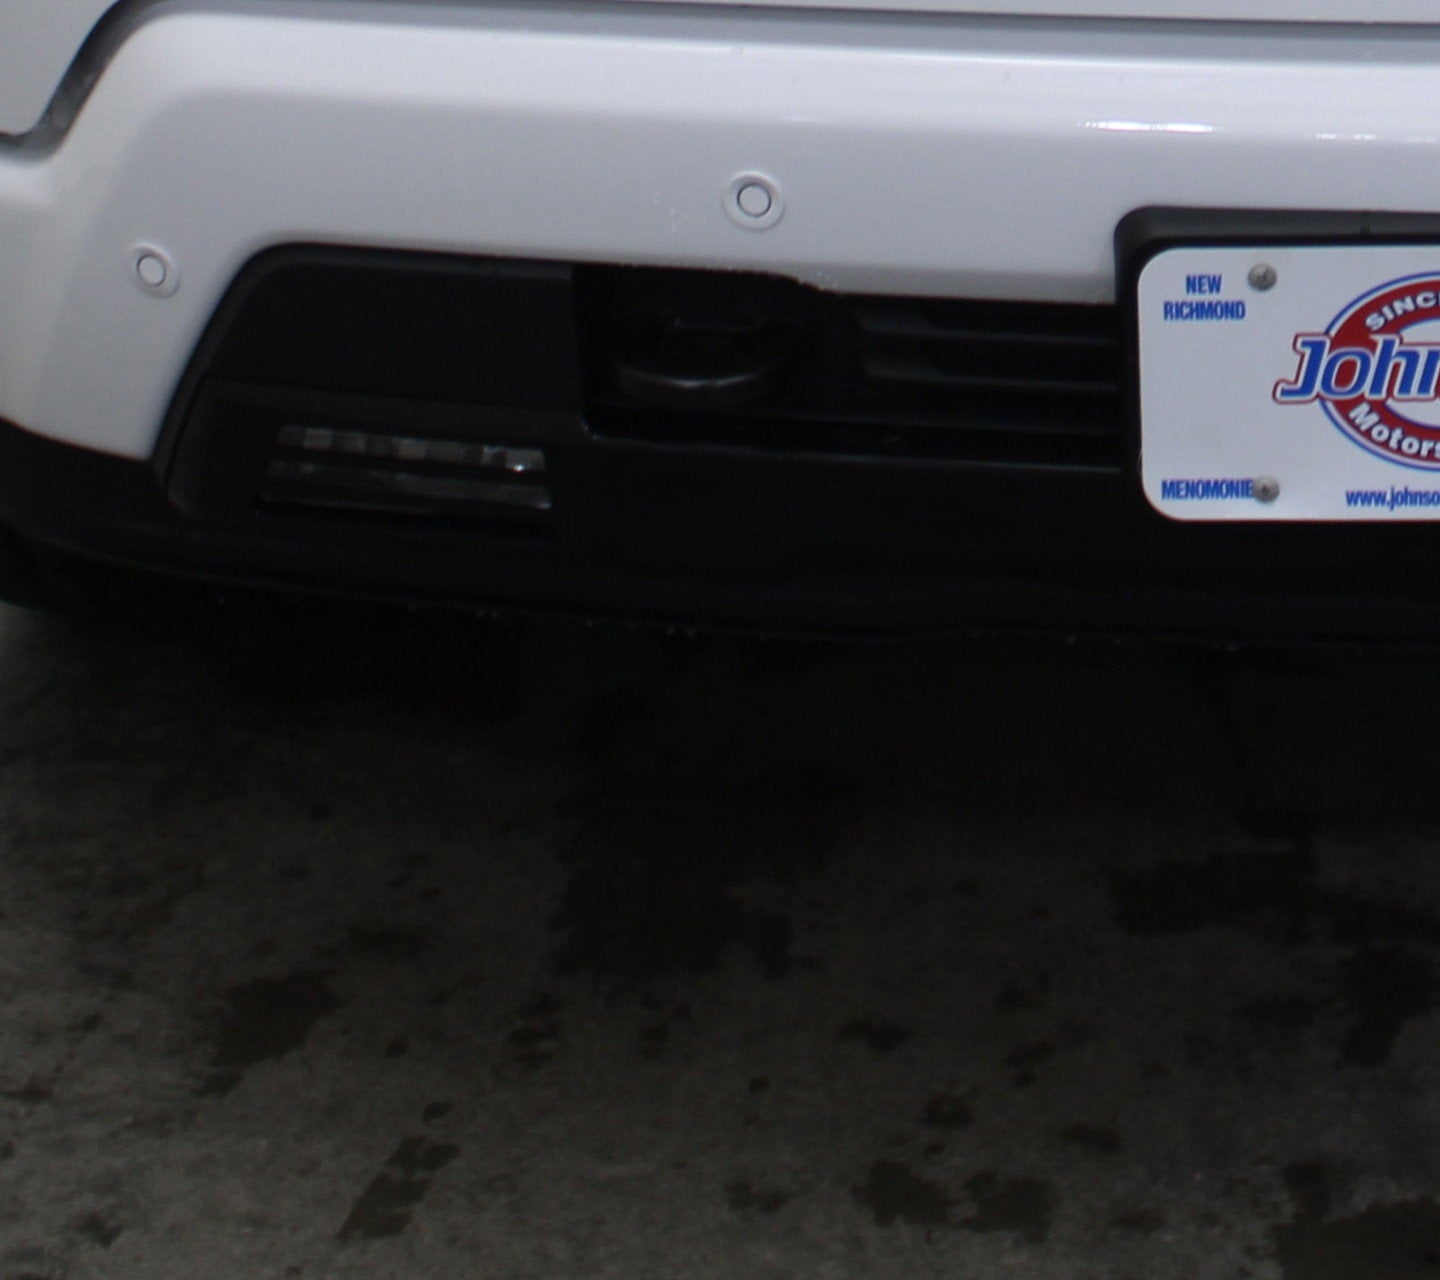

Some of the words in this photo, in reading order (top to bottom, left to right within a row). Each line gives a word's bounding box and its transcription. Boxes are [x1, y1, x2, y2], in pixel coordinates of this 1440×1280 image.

[1186, 273, 1222, 294] NEW
[1163, 300, 1246, 320] RICHMOND
[1161, 479, 1254, 499] MENOMONIE
